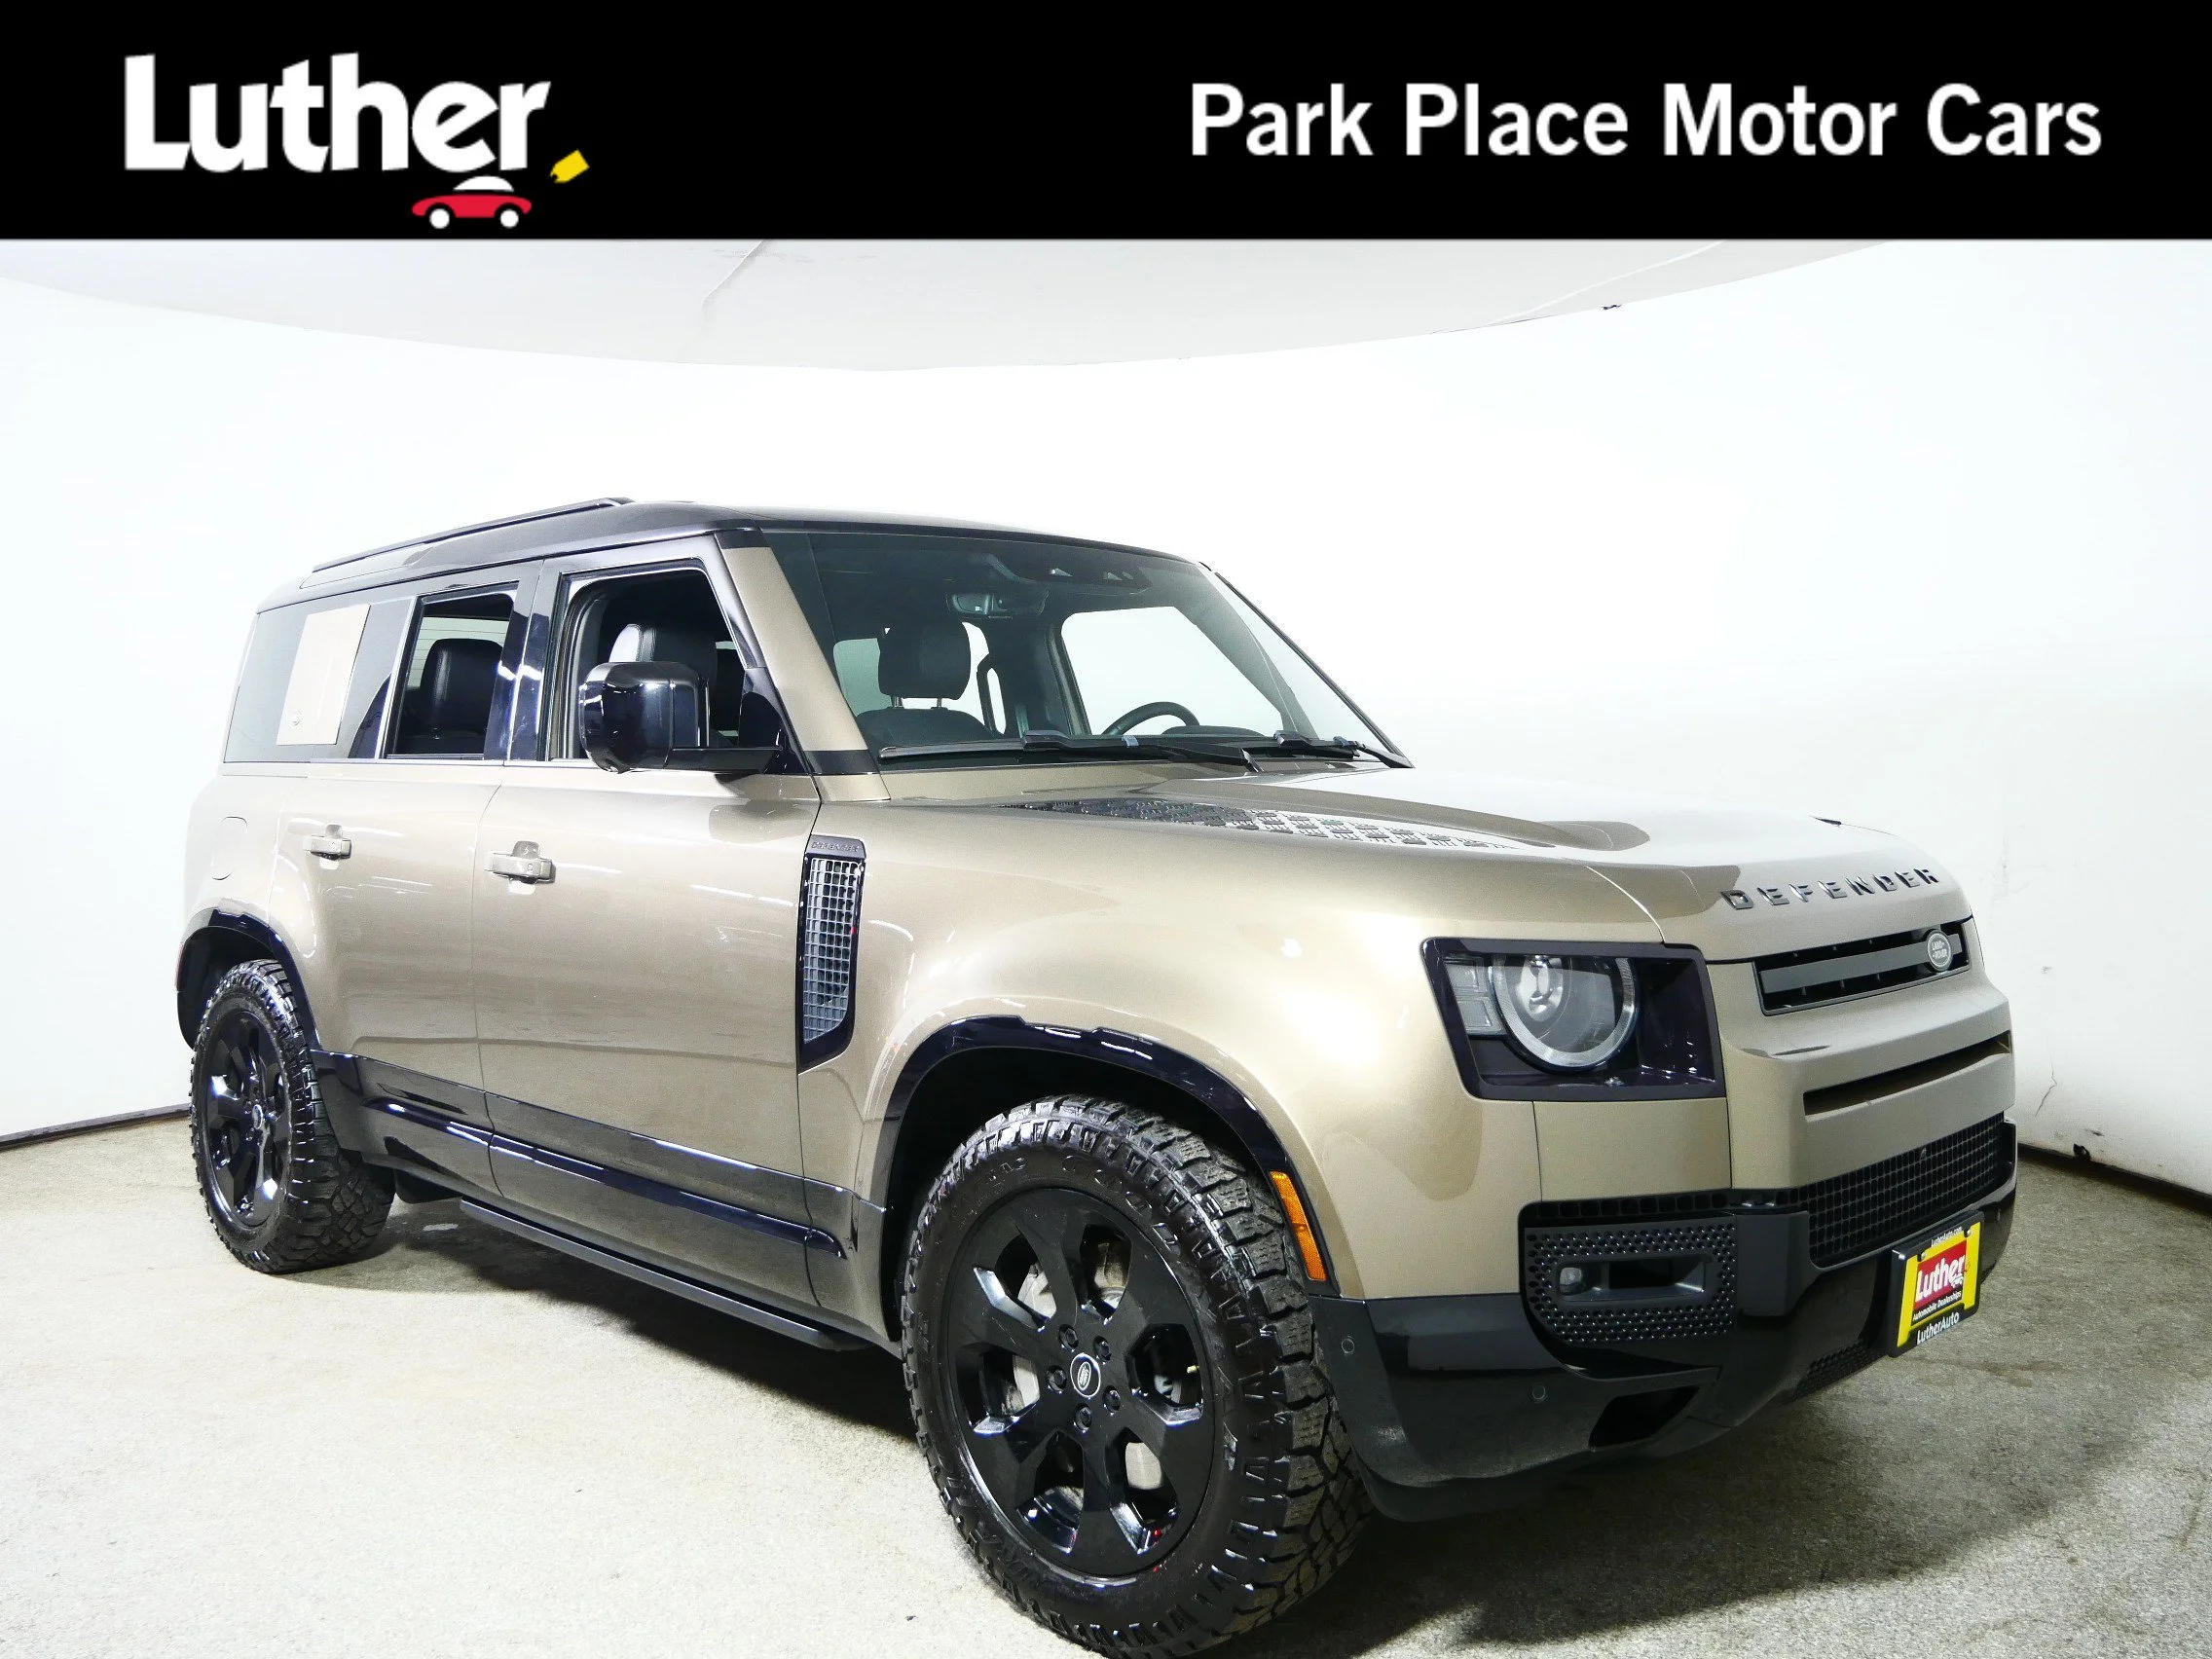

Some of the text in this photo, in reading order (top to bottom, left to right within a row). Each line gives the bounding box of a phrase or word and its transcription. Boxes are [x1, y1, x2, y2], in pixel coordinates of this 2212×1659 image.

[1720, 867, 1939, 910] DEFENDER
[1914, 1254, 1966, 1303] Luther
[1912, 1290, 1962, 1321] Automobile Dealerships
[1916, 1310, 1960, 1346] LutherAuto
